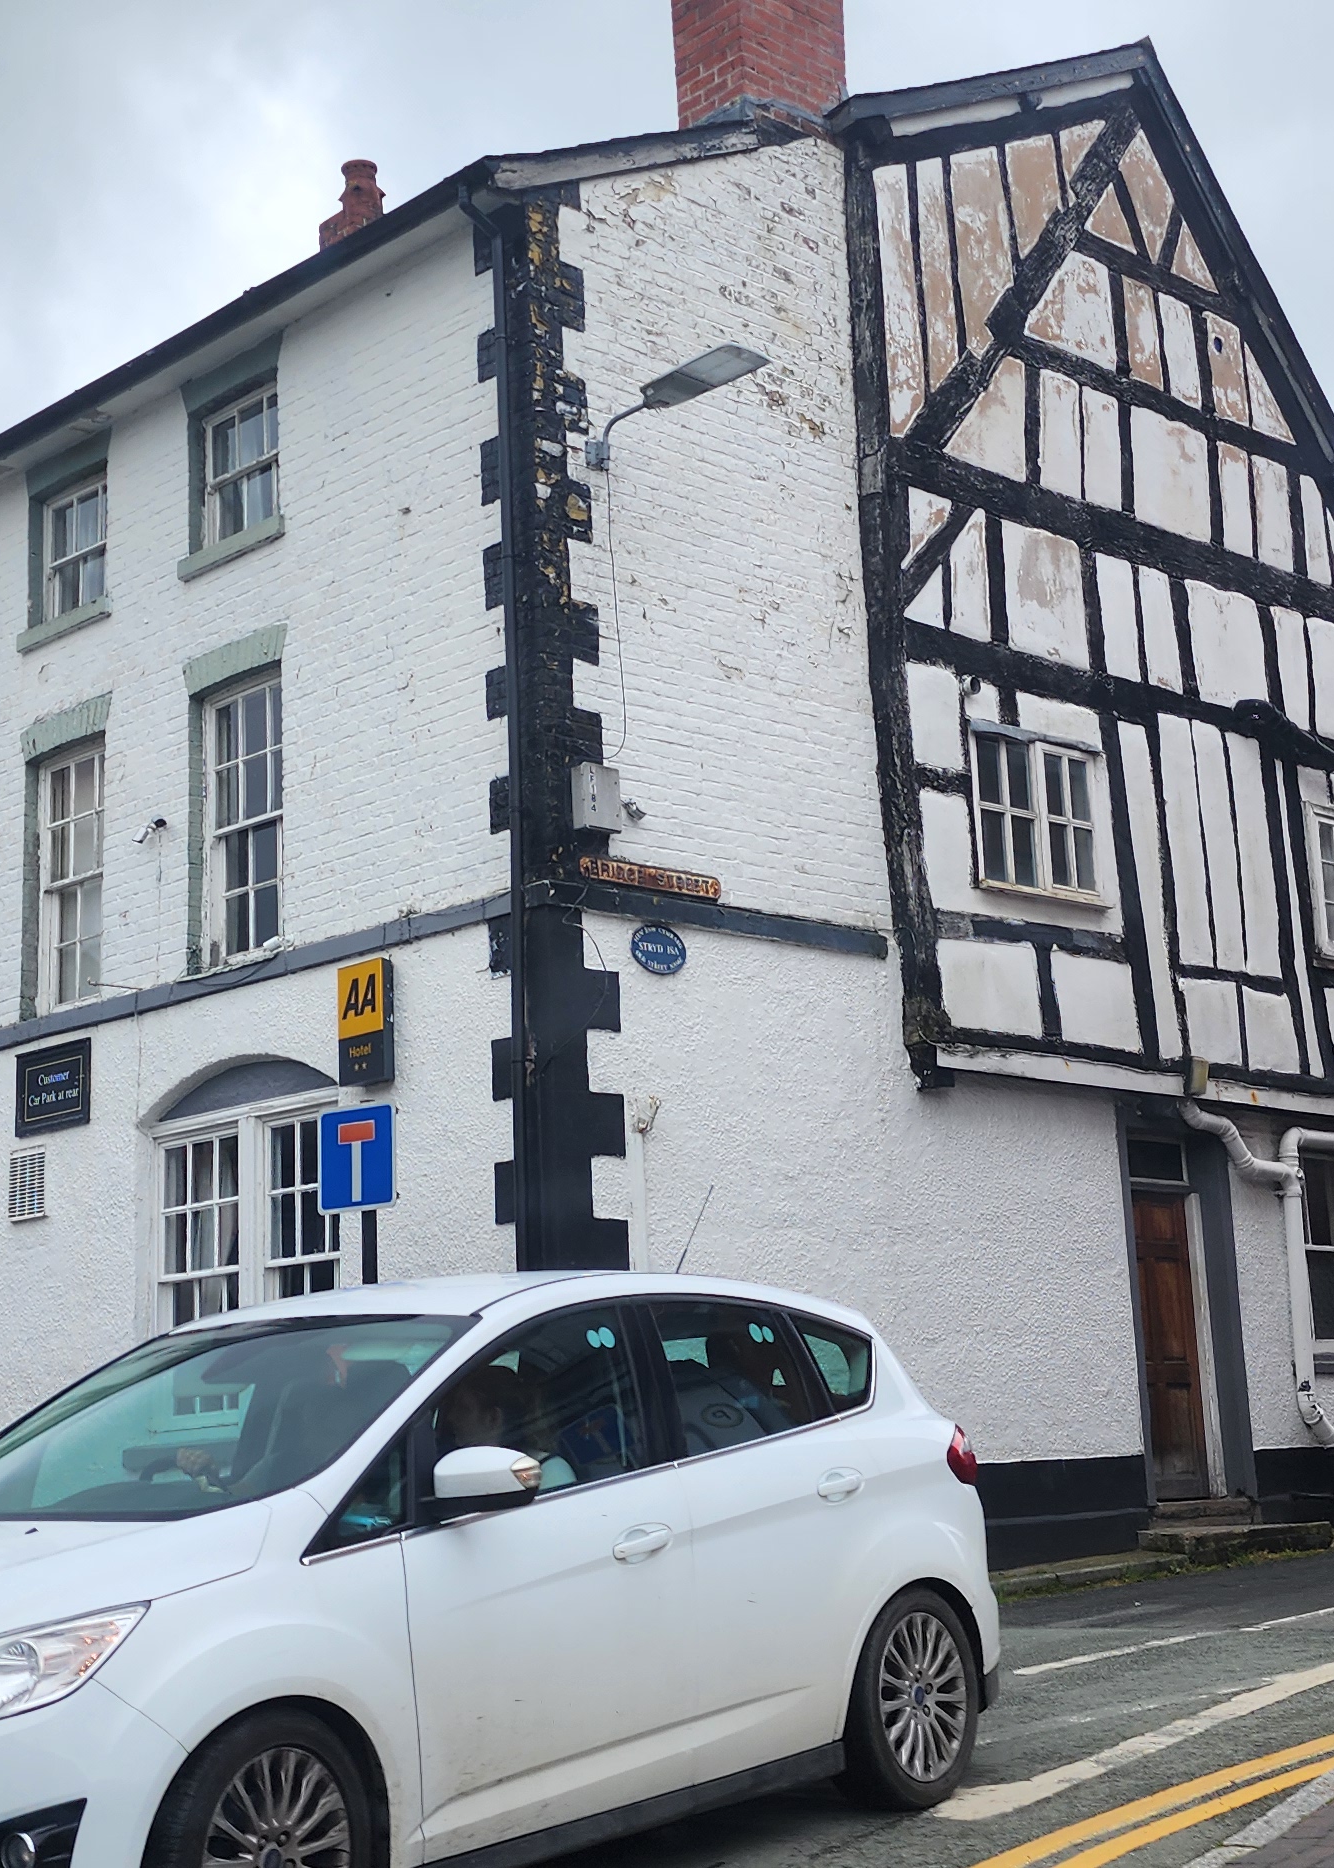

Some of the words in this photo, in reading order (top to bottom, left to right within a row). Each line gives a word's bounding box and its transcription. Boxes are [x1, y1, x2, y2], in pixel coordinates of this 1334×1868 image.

[590, 859, 645, 886] BRIDGE
[656, 872, 709, 895] STREET
[638, 941, 664, 953] STRYD
[342, 973, 376, 1020] AA
[349, 1042, 372, 1058] Hotel
[38, 1070, 70, 1086] Customer
[28, 1095, 40, 1107] Car
[41, 1090, 57, 1104] Park
[58, 1090, 65, 1100] at
[65, 1088, 79, 1099] rear
